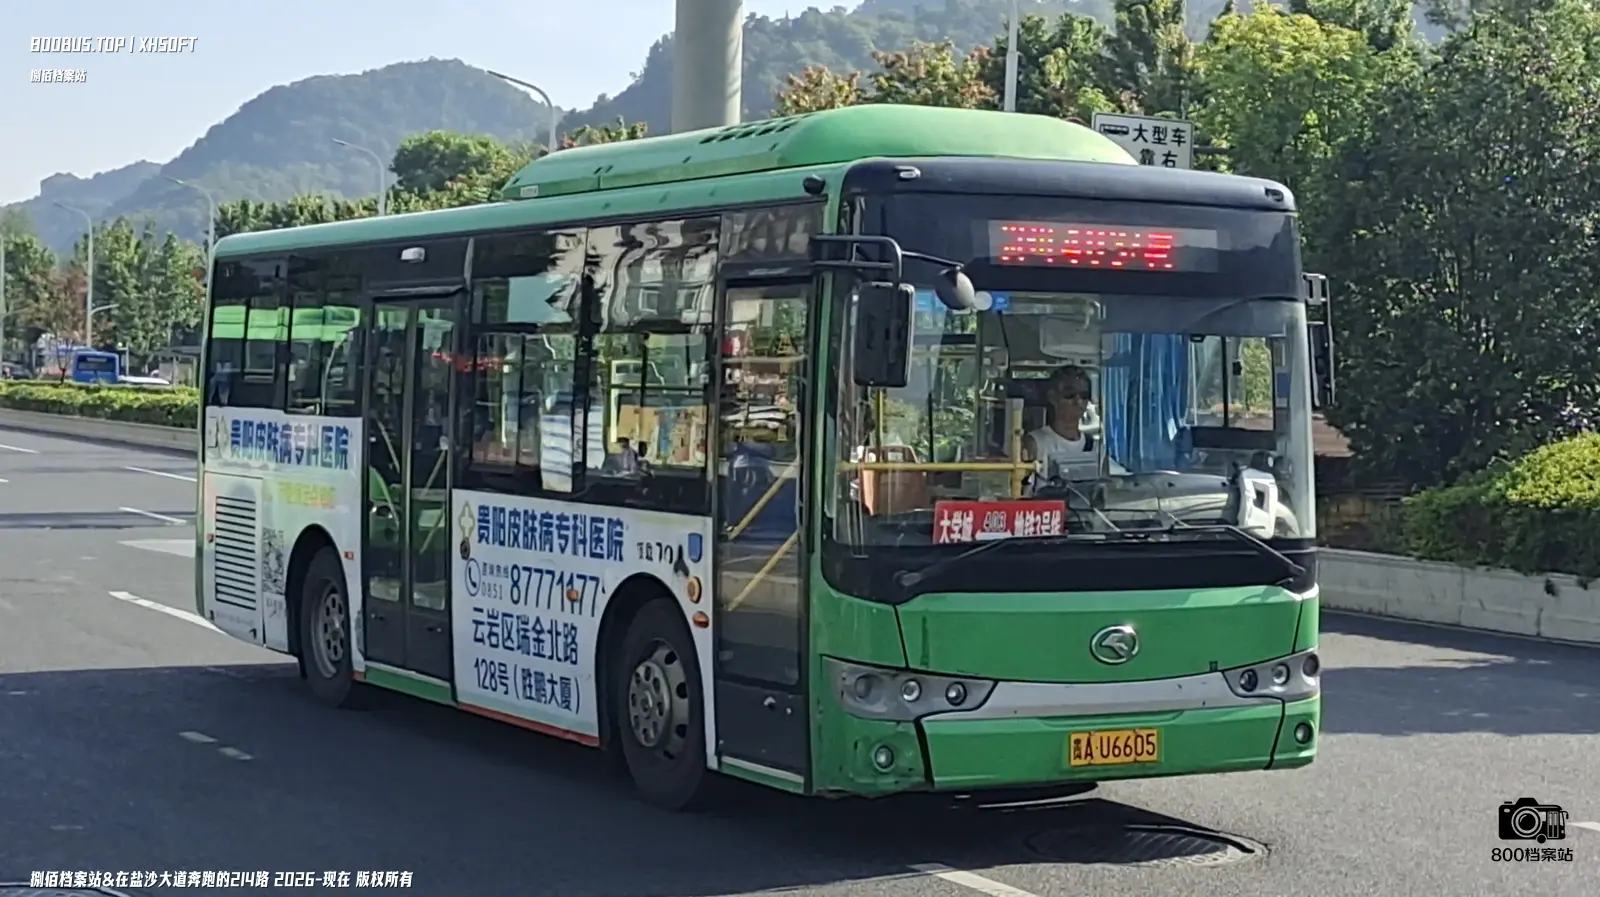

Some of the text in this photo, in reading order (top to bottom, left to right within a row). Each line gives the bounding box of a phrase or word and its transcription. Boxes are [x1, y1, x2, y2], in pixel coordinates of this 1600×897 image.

[1132, 123, 1187, 147] 大型车
[1139, 148, 1178, 168] 靠右
[231, 419, 349, 470] 贵阳皮肤病专科医院
[477, 504, 625, 562] 贵阳皮肤病专科医院
[939, 509, 974, 544] 大学城
[983, 511, 1007, 533] 403
[481, 563, 600, 618] 0851 87771177
[471, 607, 579, 666] 云岩区瑞金北路
[474, 657, 581, 715] 128号(胜鹏大厦)
[1073, 733, 1156, 760] 贵A·U6605
